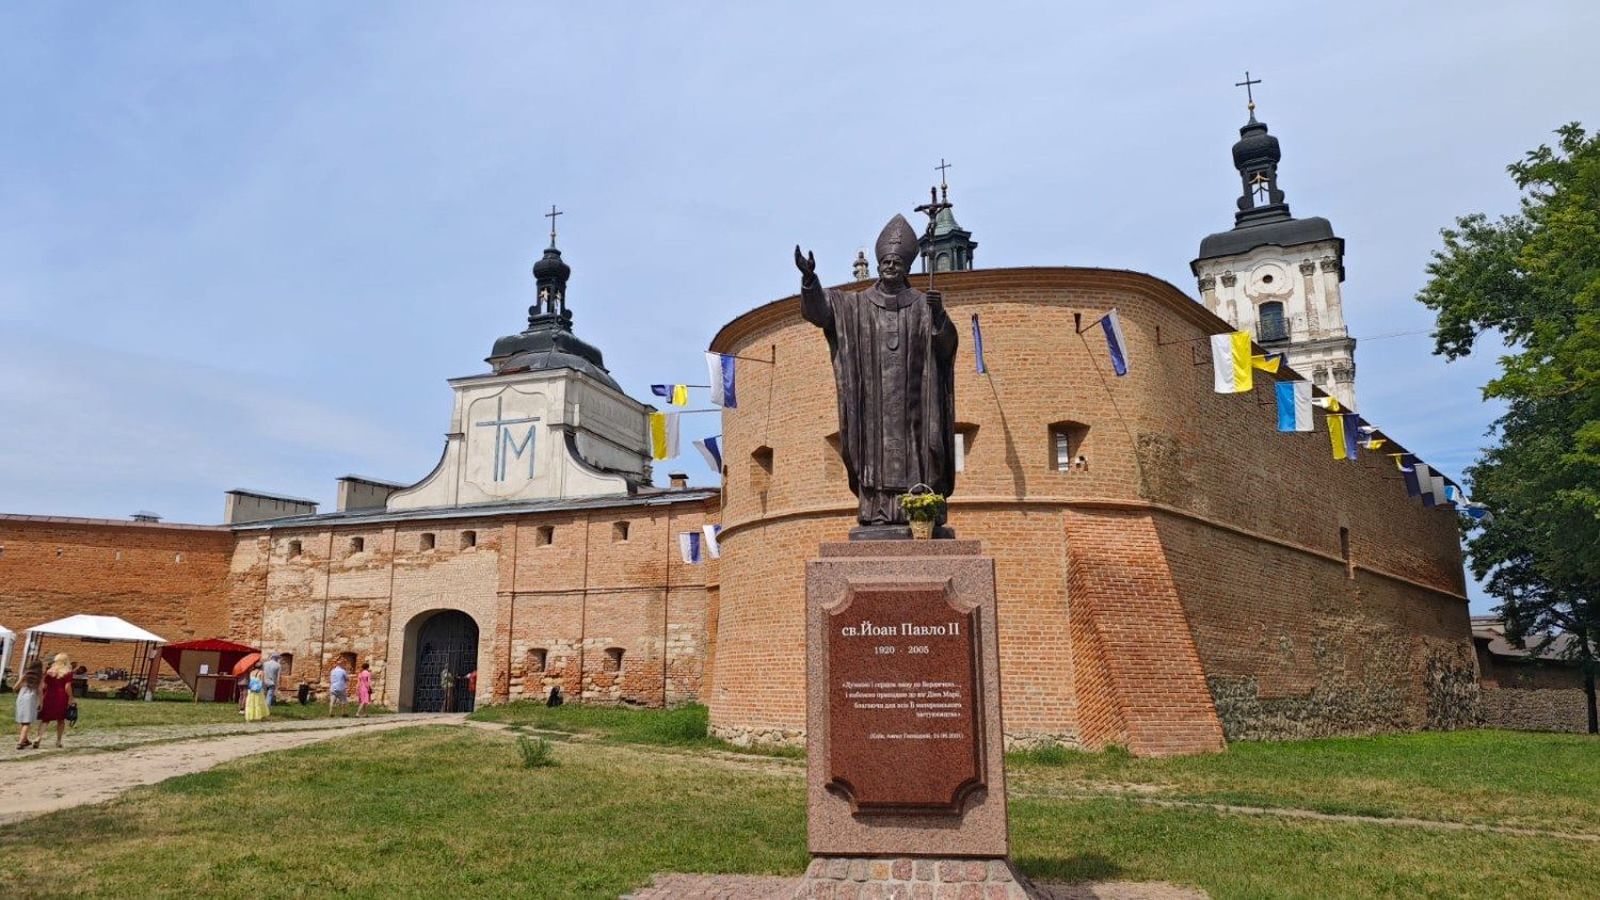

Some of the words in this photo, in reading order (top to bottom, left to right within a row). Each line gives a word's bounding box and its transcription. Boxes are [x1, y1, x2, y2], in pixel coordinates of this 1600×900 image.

[841, 621, 897, 636] св.Йоан
[901, 623, 946, 636] Павло
[949, 622, 960, 635] II
[874, 646, 895, 655] 1920
[908, 646, 930, 655] 2005
